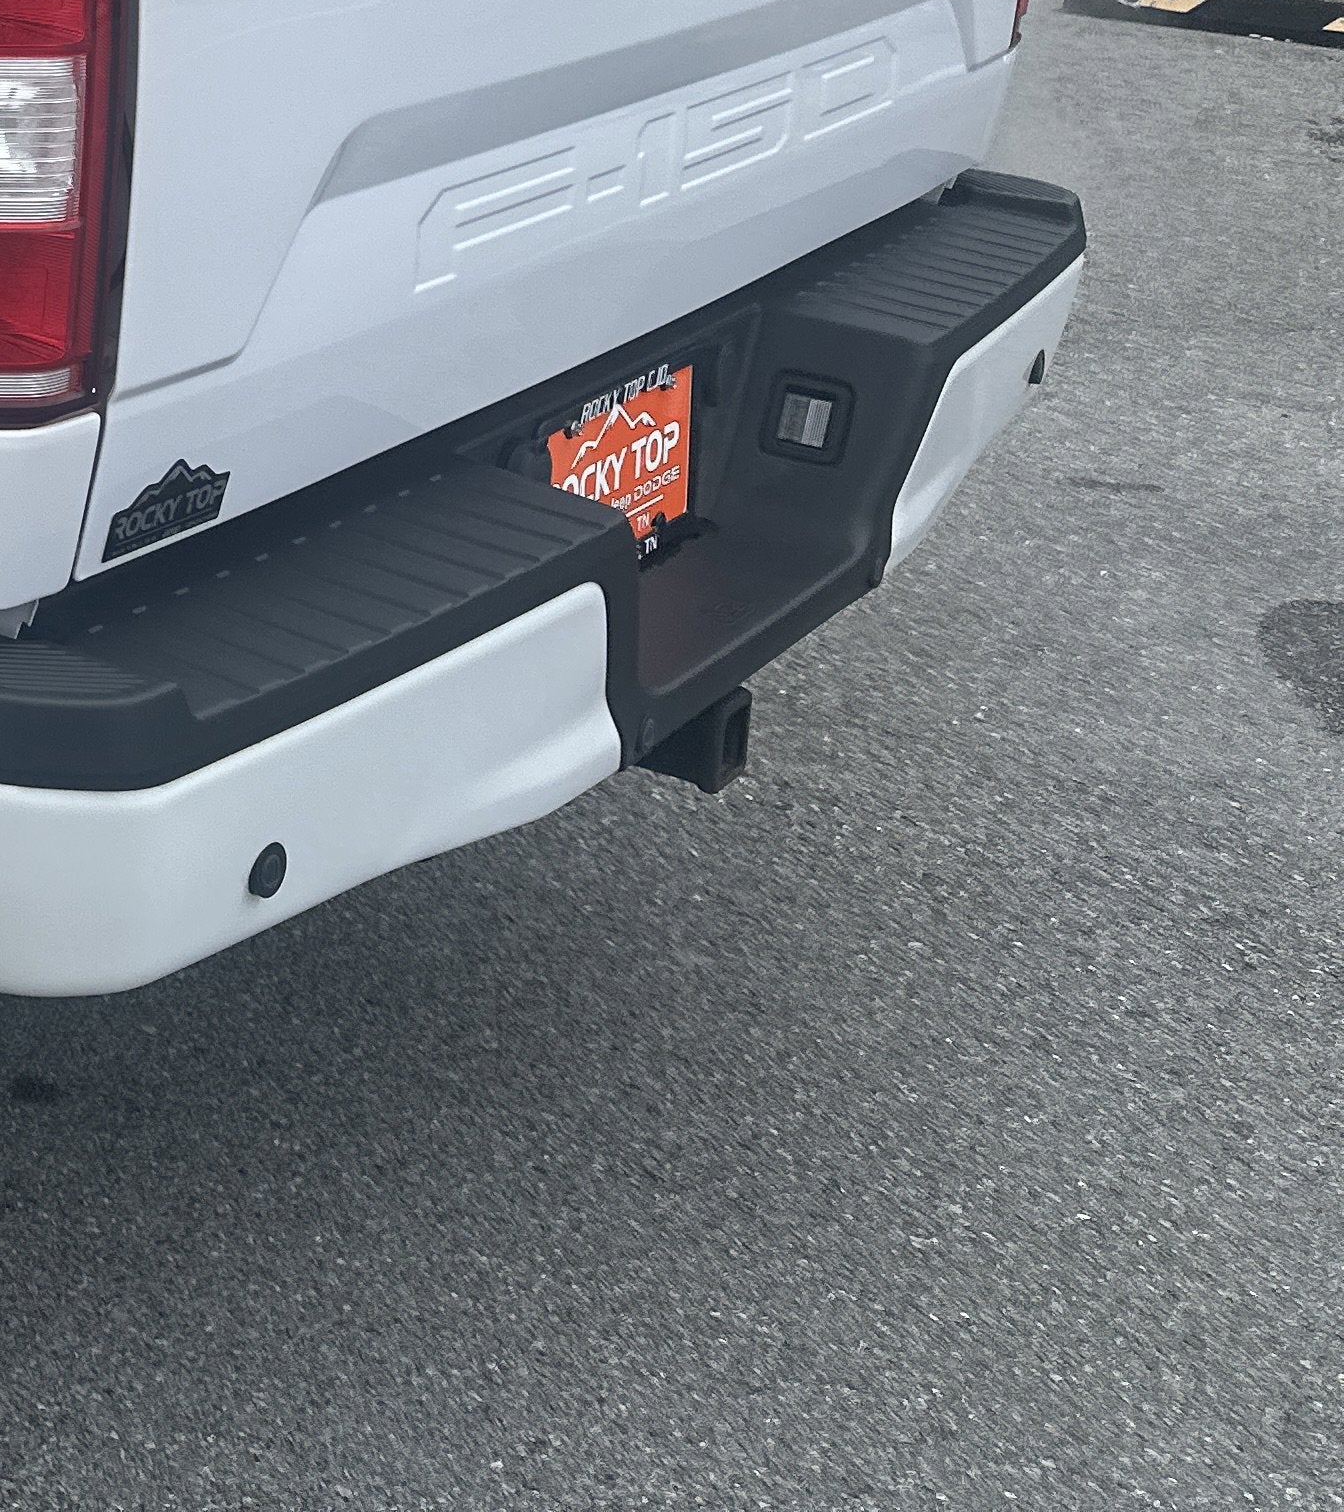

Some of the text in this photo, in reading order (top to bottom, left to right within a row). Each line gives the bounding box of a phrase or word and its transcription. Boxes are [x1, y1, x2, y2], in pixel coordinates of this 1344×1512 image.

[413, 35, 899, 294] F-150
[580, 389, 621, 425] ROCKY
[623, 375, 646, 403] TOP
[631, 420, 681, 479] TOP
[113, 494, 183, 540] ROCKY
[185, 479, 227, 515] TOP
[633, 464, 681, 502] DODGE
